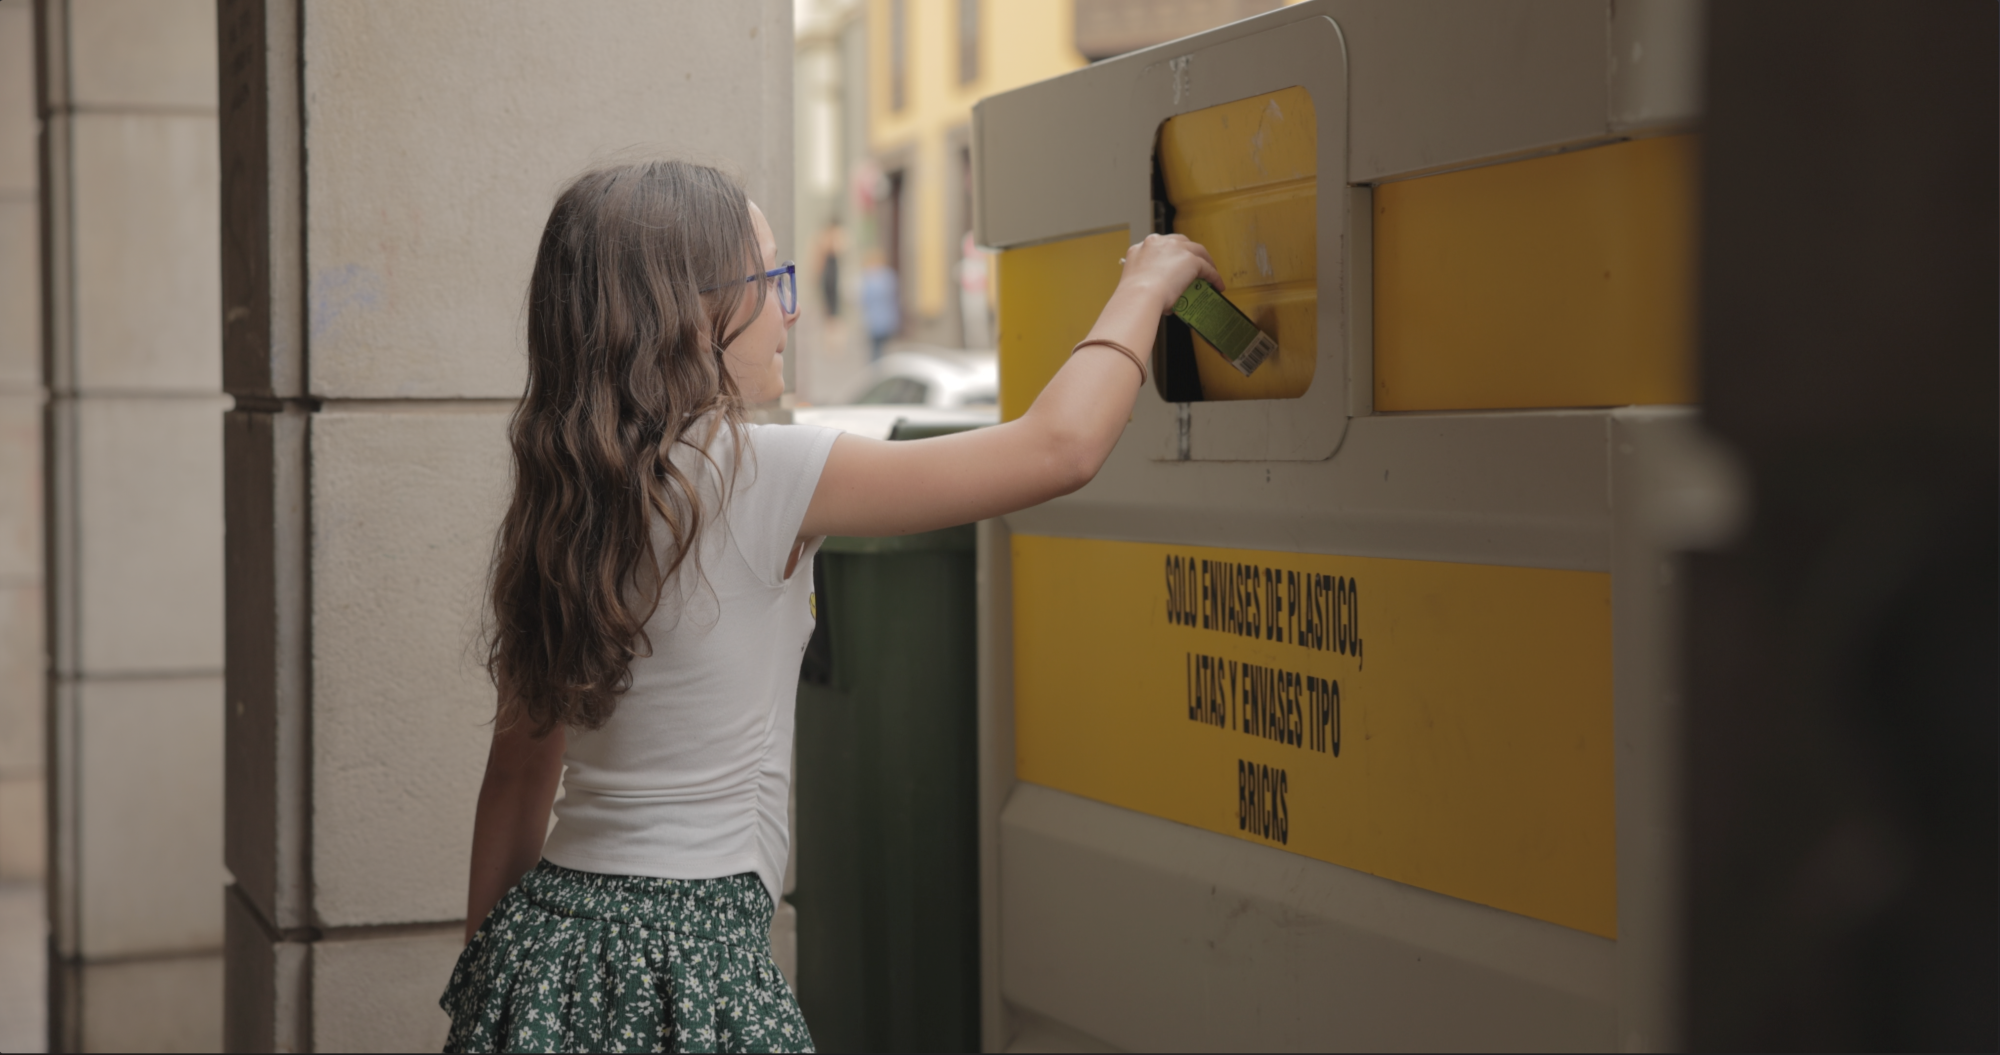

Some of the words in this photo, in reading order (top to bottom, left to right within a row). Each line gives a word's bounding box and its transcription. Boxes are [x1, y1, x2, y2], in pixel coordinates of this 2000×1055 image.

[1165, 554, 1197, 629] SOLO
[1202, 559, 1261, 640] ENVASES
[1265, 567, 1284, 643] DE
[1288, 570, 1363, 672] PLASTICO,
[1187, 652, 1226, 729] LATAS
[1228, 660, 1238, 731] Y
[1242, 662, 1303, 749] ENVASES
[1306, 675, 1341, 758] TIPO
[1238, 758, 1288, 846] BRICKS
